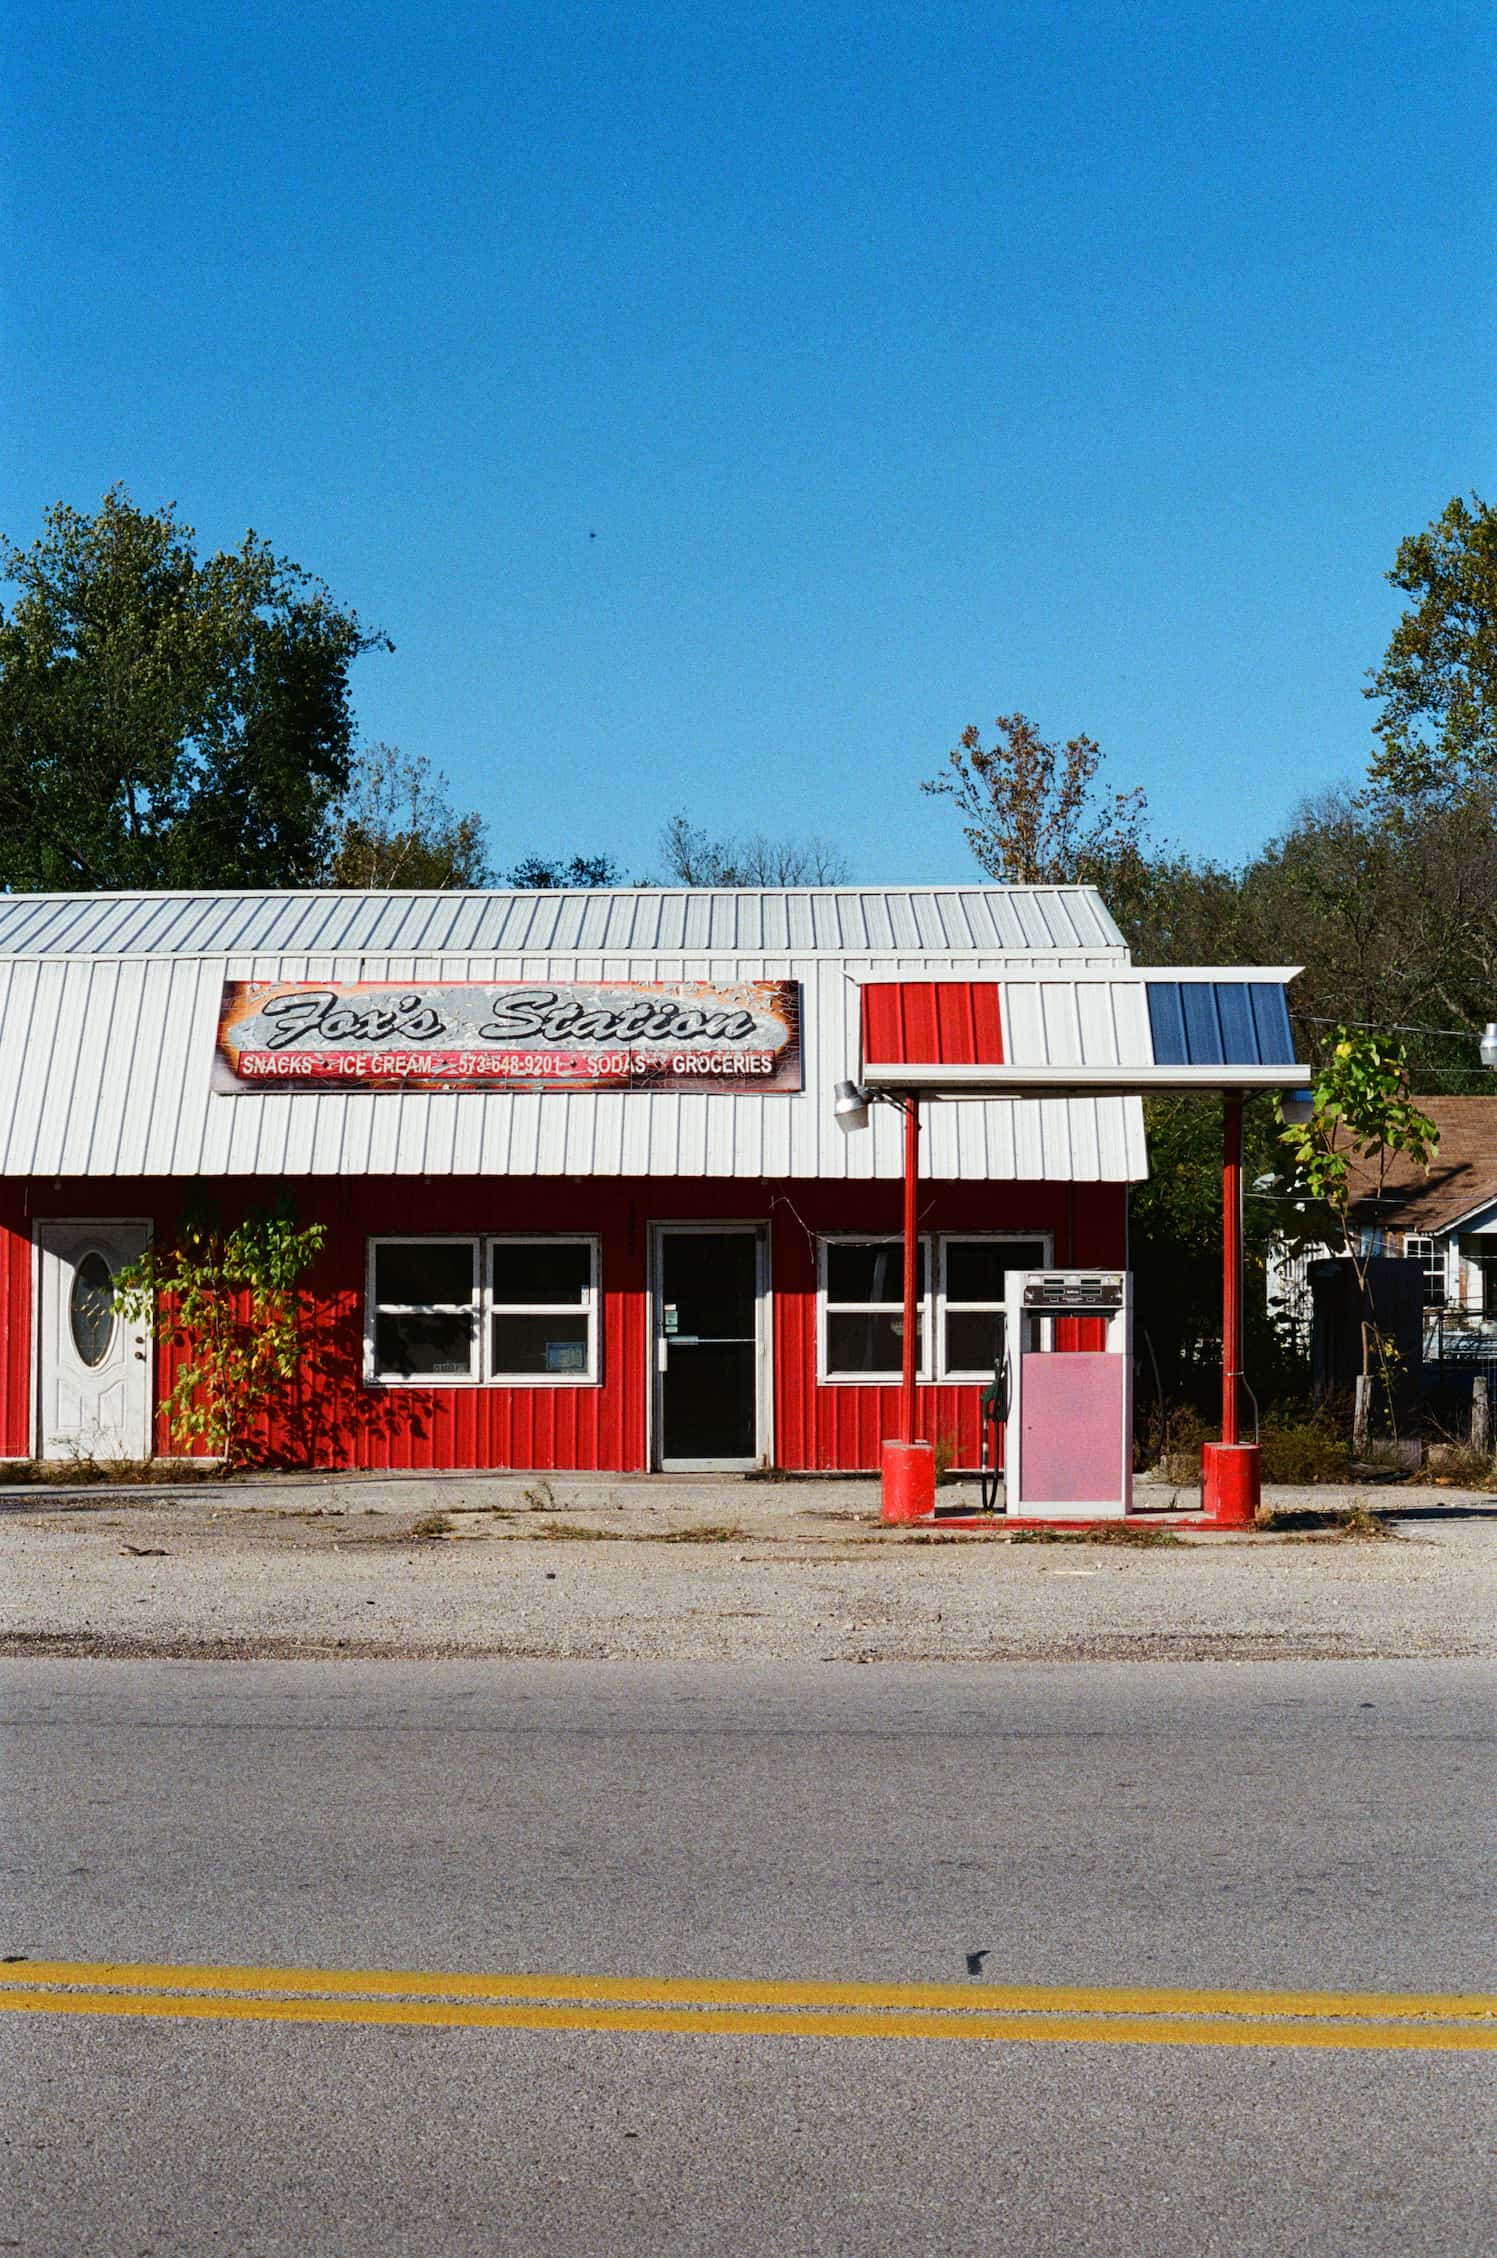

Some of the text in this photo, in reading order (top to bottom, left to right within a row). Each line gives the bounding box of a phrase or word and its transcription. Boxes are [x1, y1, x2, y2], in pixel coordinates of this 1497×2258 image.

[262, 991, 756, 1049] Fox's Station
[243, 1055, 773, 1074] SNACKS ICE CREAM 573-648-9201 SODAS GROCERIES
